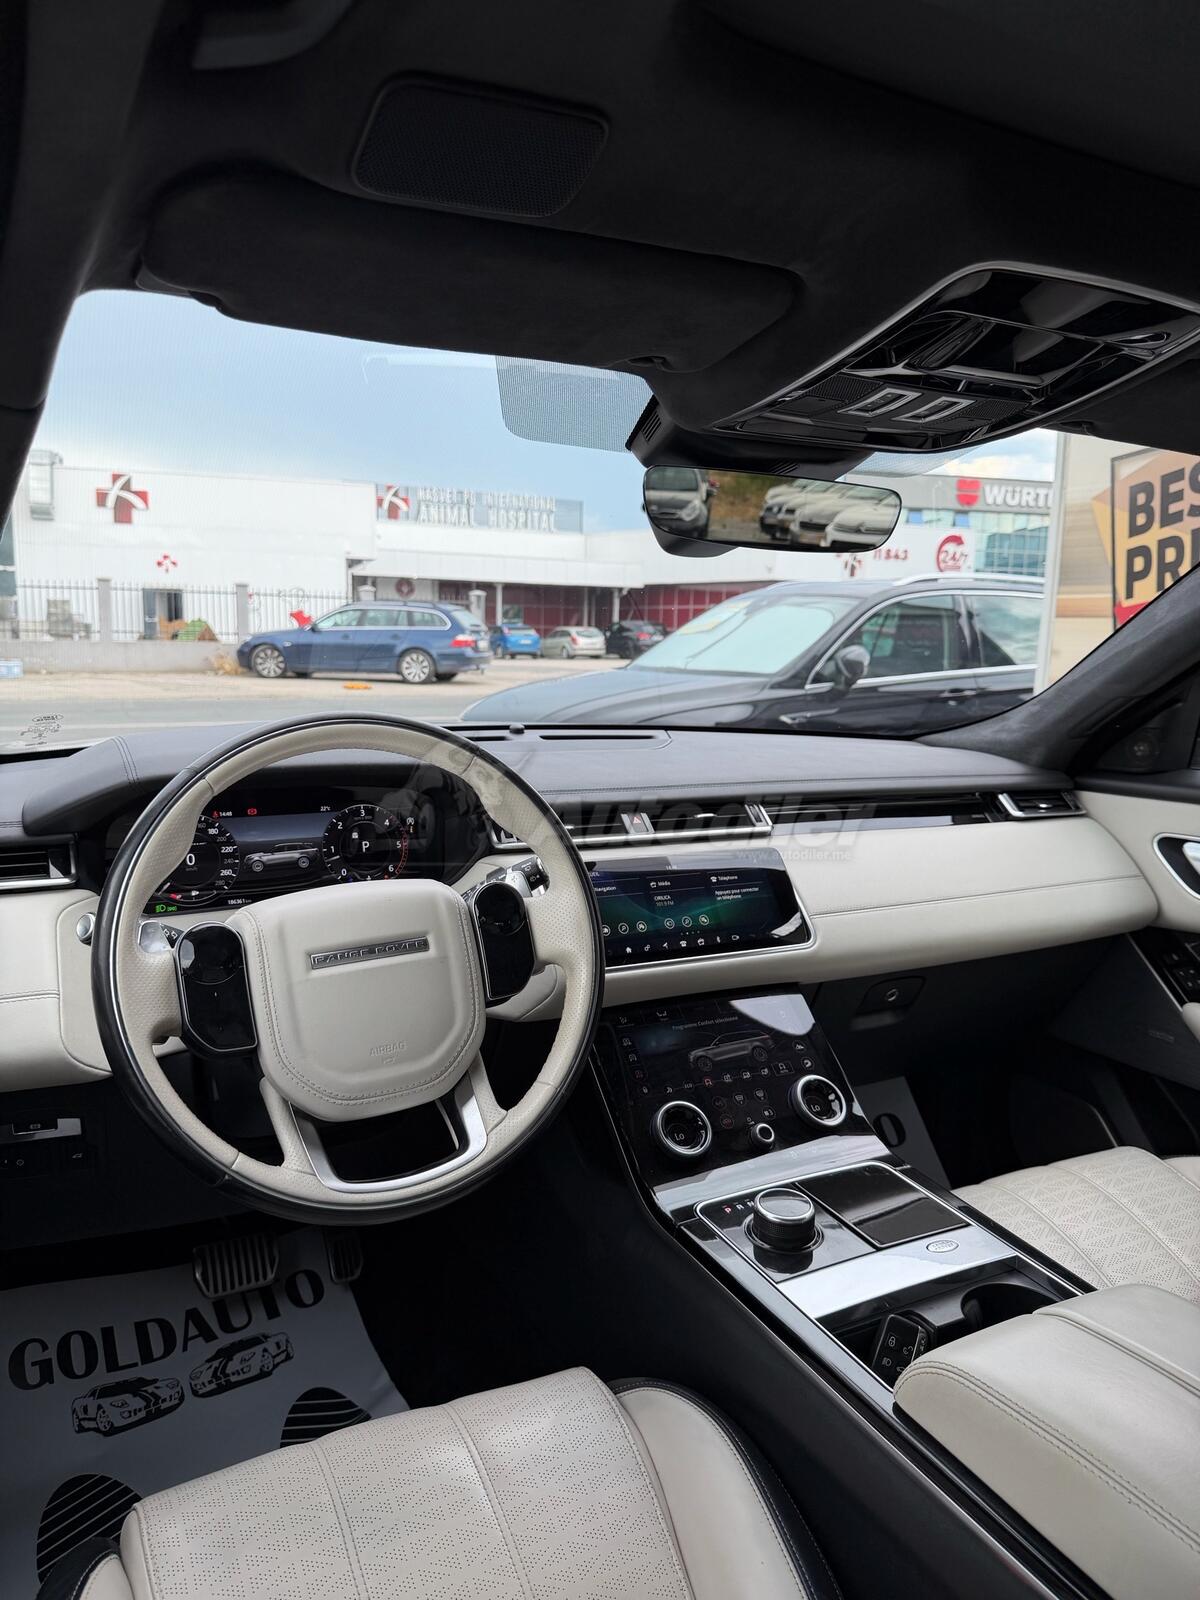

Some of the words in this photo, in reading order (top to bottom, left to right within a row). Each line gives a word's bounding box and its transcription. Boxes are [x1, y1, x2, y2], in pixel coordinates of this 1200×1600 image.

[418, 504, 475, 527] ANIMAL
[488, 508, 557, 532] HOSPITAL
[360, 809, 366, 817] 3
[337, 821, 343, 830] 2
[330, 845, 335, 853] 1
[361, 840, 370, 853] P
[396, 840, 402, 849] 5
[185, 853, 196, 866] 0
[223, 857, 235, 865] 240
[341, 868, 347, 876] 0
[388, 864, 394, 872] 6
[219, 869, 233, 877] 260
[315, 948, 369, 966] RANGE
[375, 940, 425, 956] ROVER
[810, 1103, 821, 1112] Lo
[674, 1132, 685, 1141] Lo
[8, 1269, 325, 1391] GOLDAUTO
